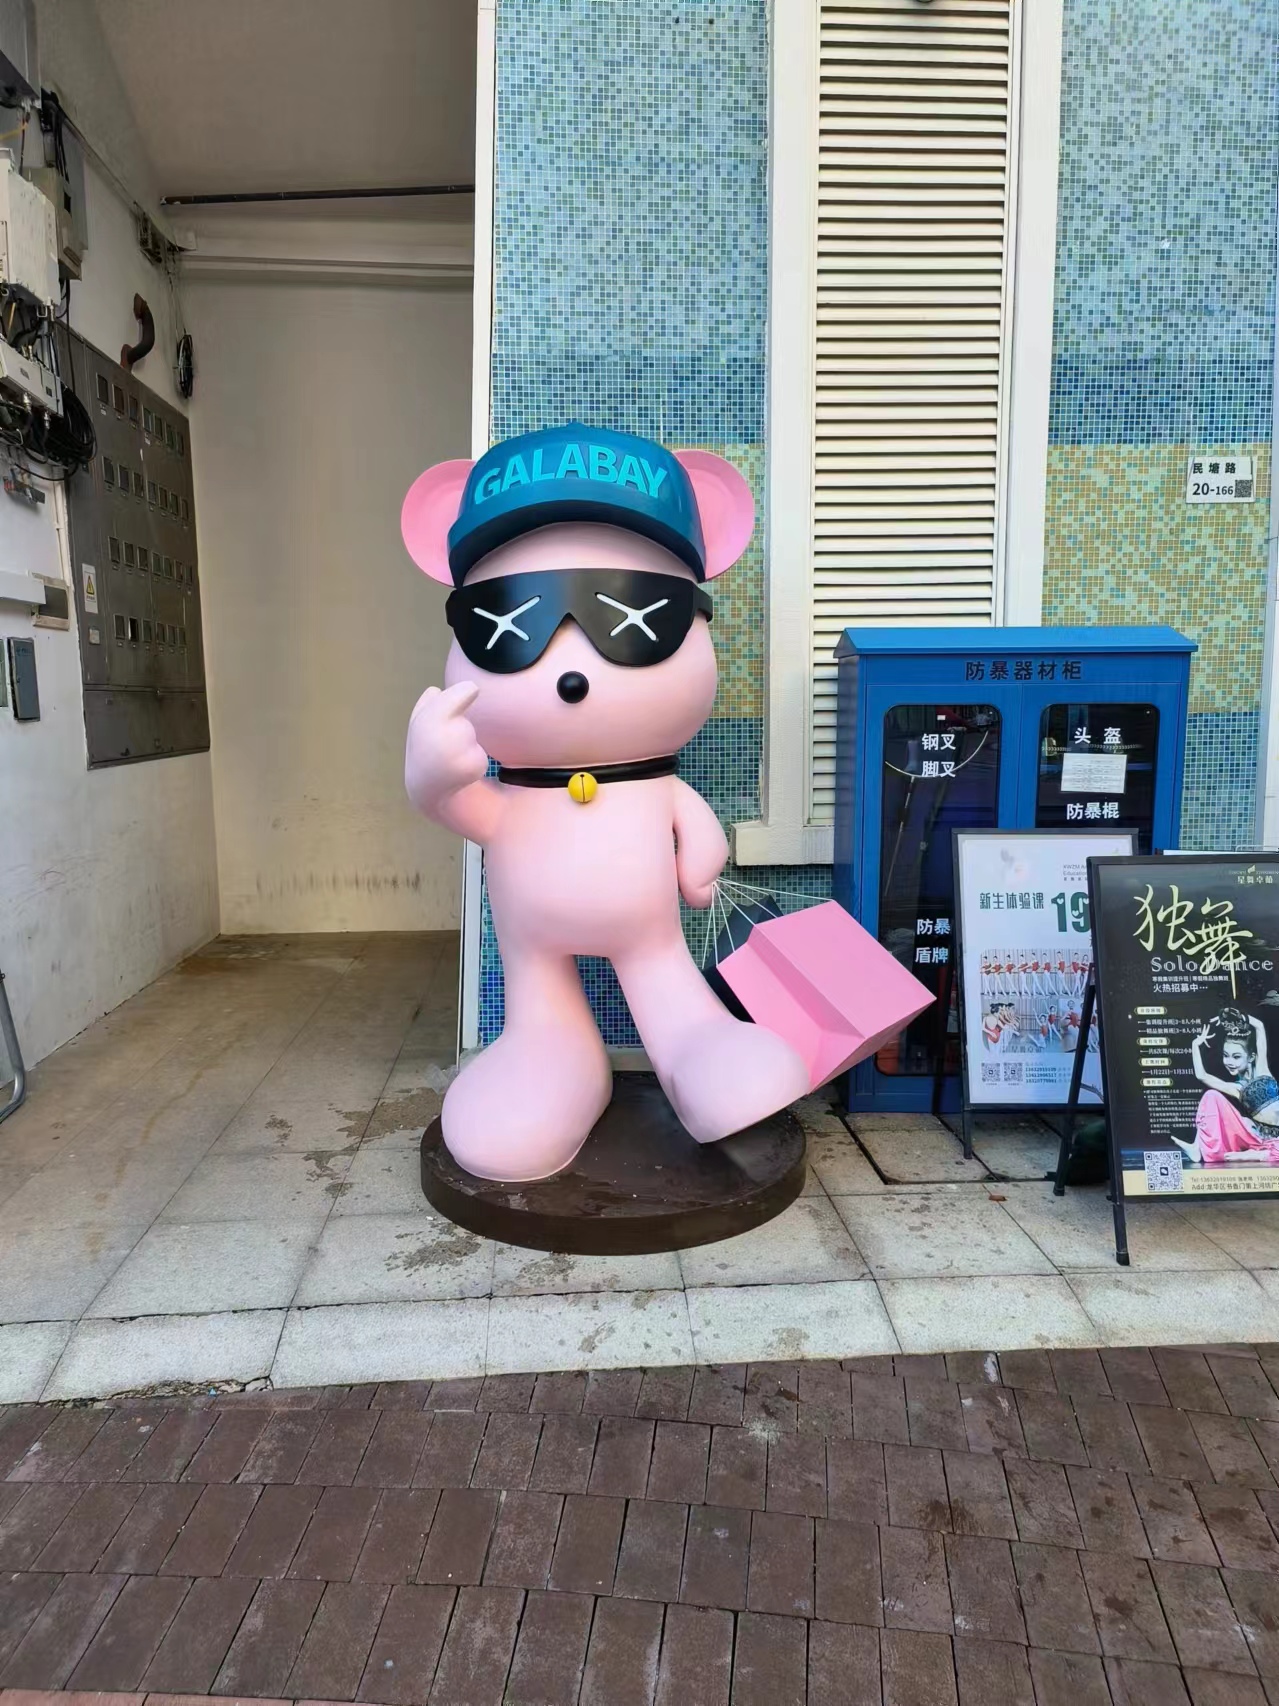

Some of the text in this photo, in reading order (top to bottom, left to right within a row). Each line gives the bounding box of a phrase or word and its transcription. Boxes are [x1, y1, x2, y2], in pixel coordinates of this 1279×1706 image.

[474, 443, 668, 505] GALABAY
[1192, 462, 1236, 474] 民塘路
[1191, 482, 1234, 496] 20-166
[965, 660, 1083, 681] 防暴器材柜
[921, 733, 956, 751] 钢叉
[1074, 726, 1122, 745] 头盔
[921, 760, 956, 778] 脚叉
[1066, 801, 1120, 820] 防暴棍
[979, 892, 1044, 910] 新生体验课
[916, 917, 951, 936] 防暴
[1132, 884, 1254, 1000] 独舞
[914, 947, 949, 964] 盾牌
[1151, 955, 1274, 972] Solo Dance
